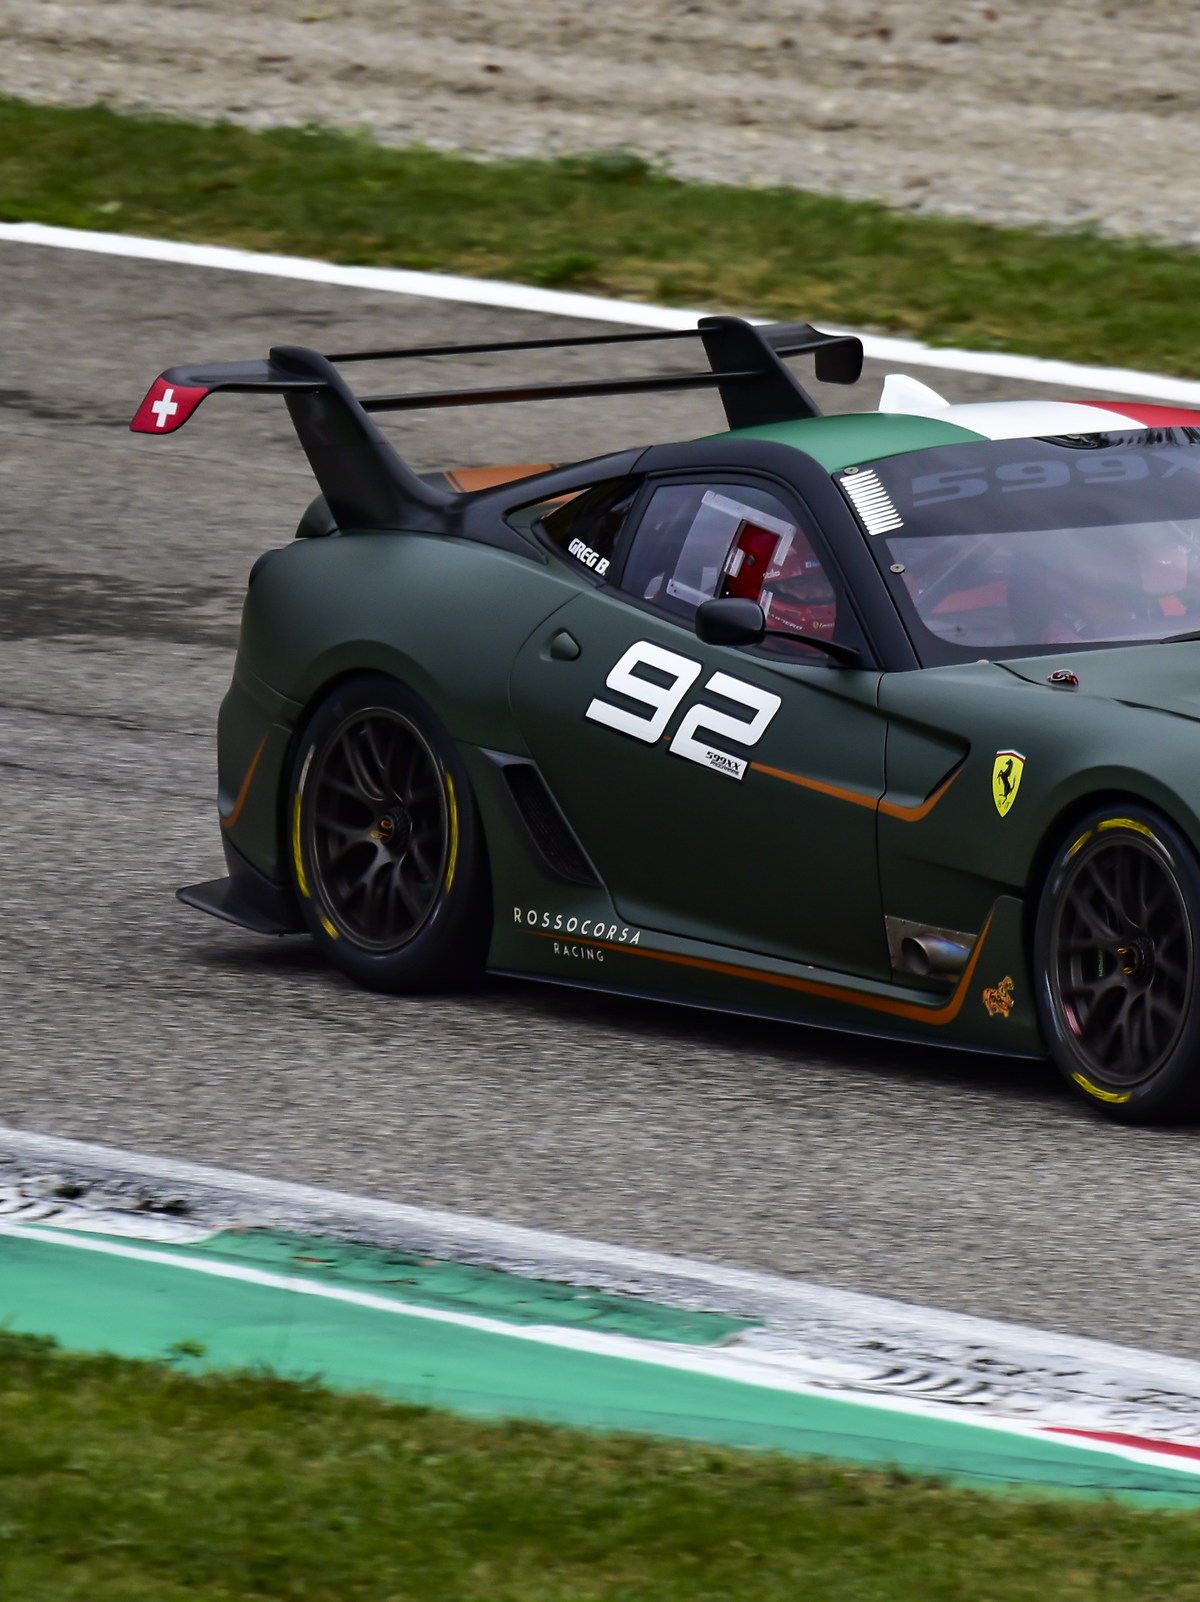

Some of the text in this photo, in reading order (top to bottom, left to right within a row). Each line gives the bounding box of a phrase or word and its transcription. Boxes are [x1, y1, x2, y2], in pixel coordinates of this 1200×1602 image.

[568, 537, 610, 577] GREG B.
[585, 640, 782, 781] 92
[705, 750, 741, 771] 599XX
[513, 907, 641, 945] ROSSOCORSA
[553, 942, 605, 963] RACING
